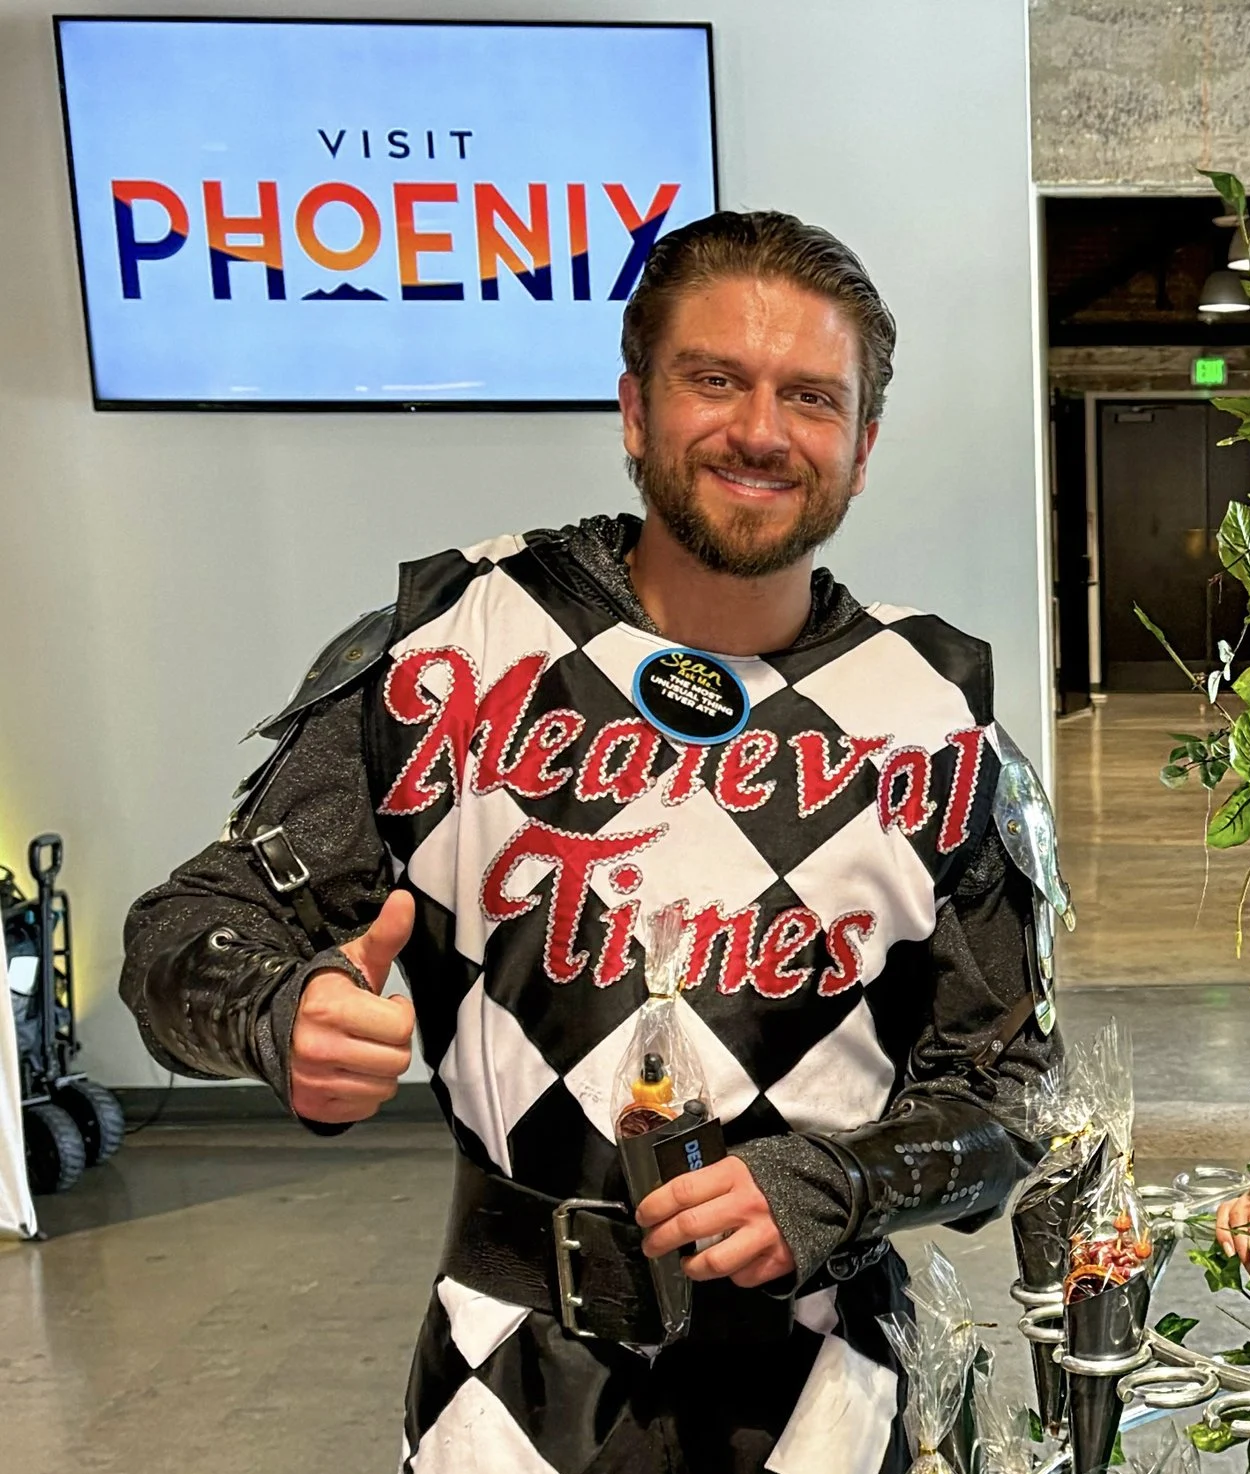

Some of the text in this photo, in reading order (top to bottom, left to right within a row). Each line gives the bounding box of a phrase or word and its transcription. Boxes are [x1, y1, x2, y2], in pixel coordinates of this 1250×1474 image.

[317, 129, 474, 160] VISIT
[111, 180, 682, 301] PHOENIX
[660, 652, 722, 687] Sean
[650, 675, 734, 717] UNUSUAL THING
[667, 691, 696, 708] EVER
[695, 705, 717, 718] ATE
[669, 674, 722, 701] THE MOST
[481, 817, 878, 999] Times
